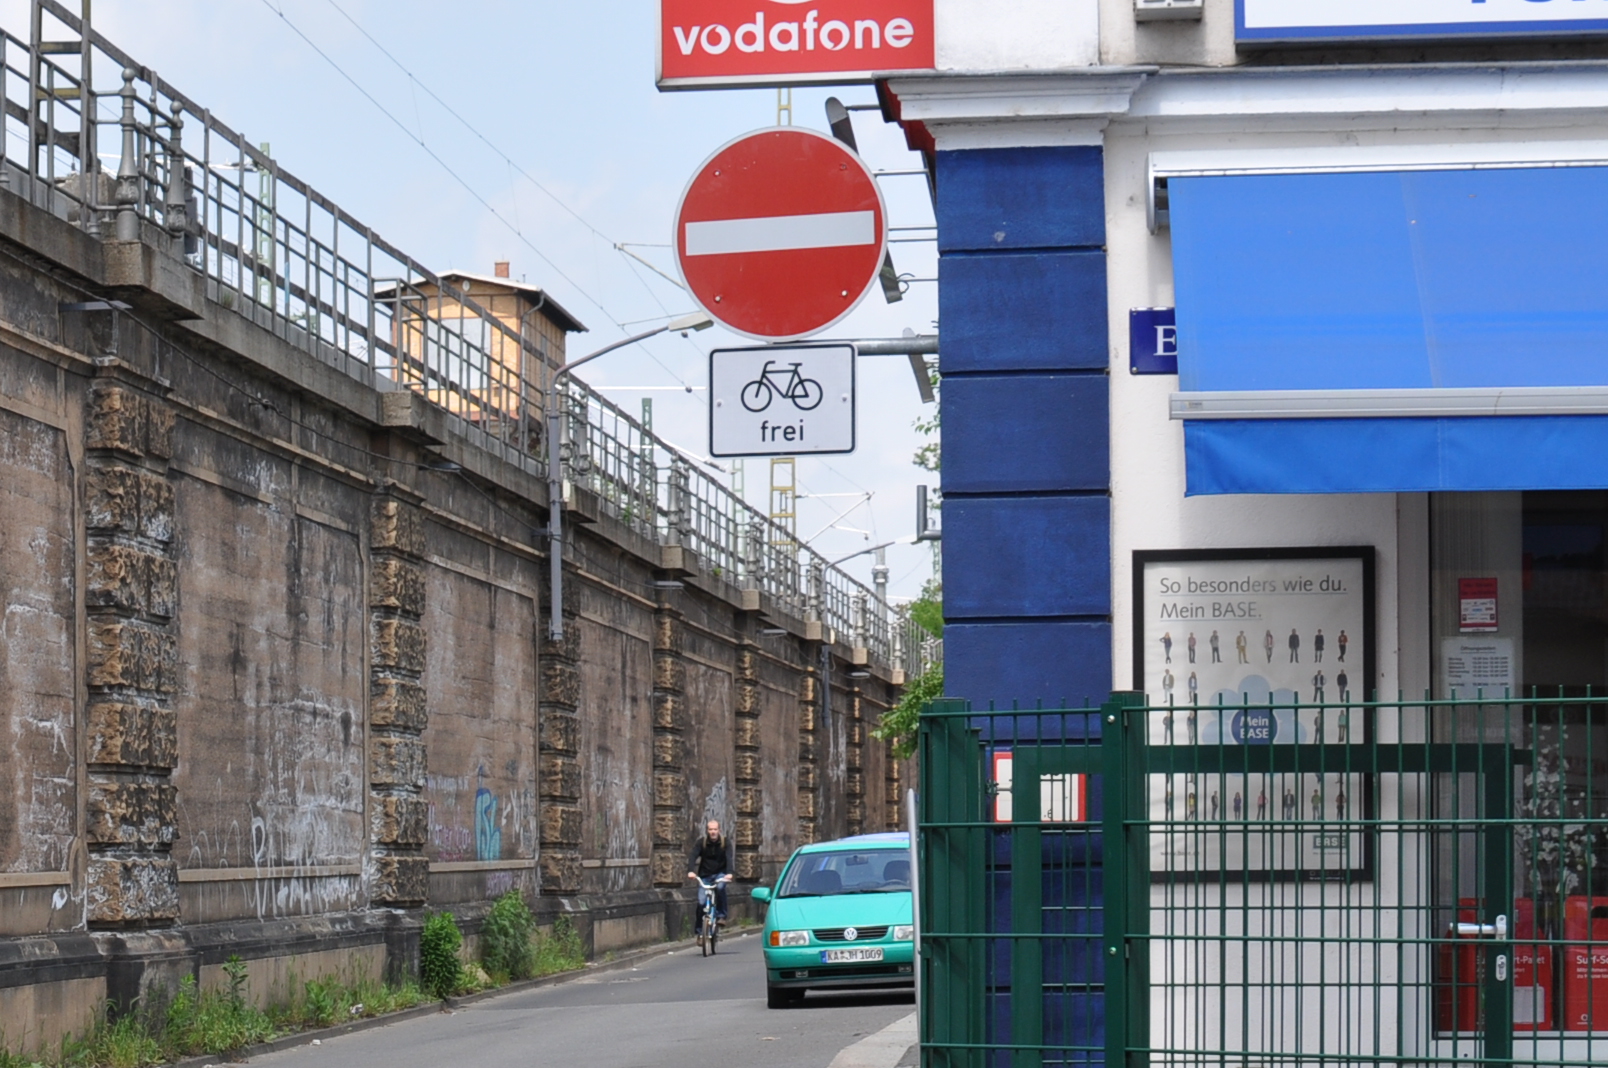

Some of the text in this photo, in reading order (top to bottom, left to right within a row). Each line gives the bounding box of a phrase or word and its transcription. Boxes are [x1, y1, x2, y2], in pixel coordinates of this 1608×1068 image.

[673, 9, 915, 56] vodafone
[760, 418, 805, 443] frei
[1159, 574, 1348, 594] So besonders wie du.
[1159, 601, 1263, 619] Mein BASE.
[1239, 715, 1269, 727] Mein
